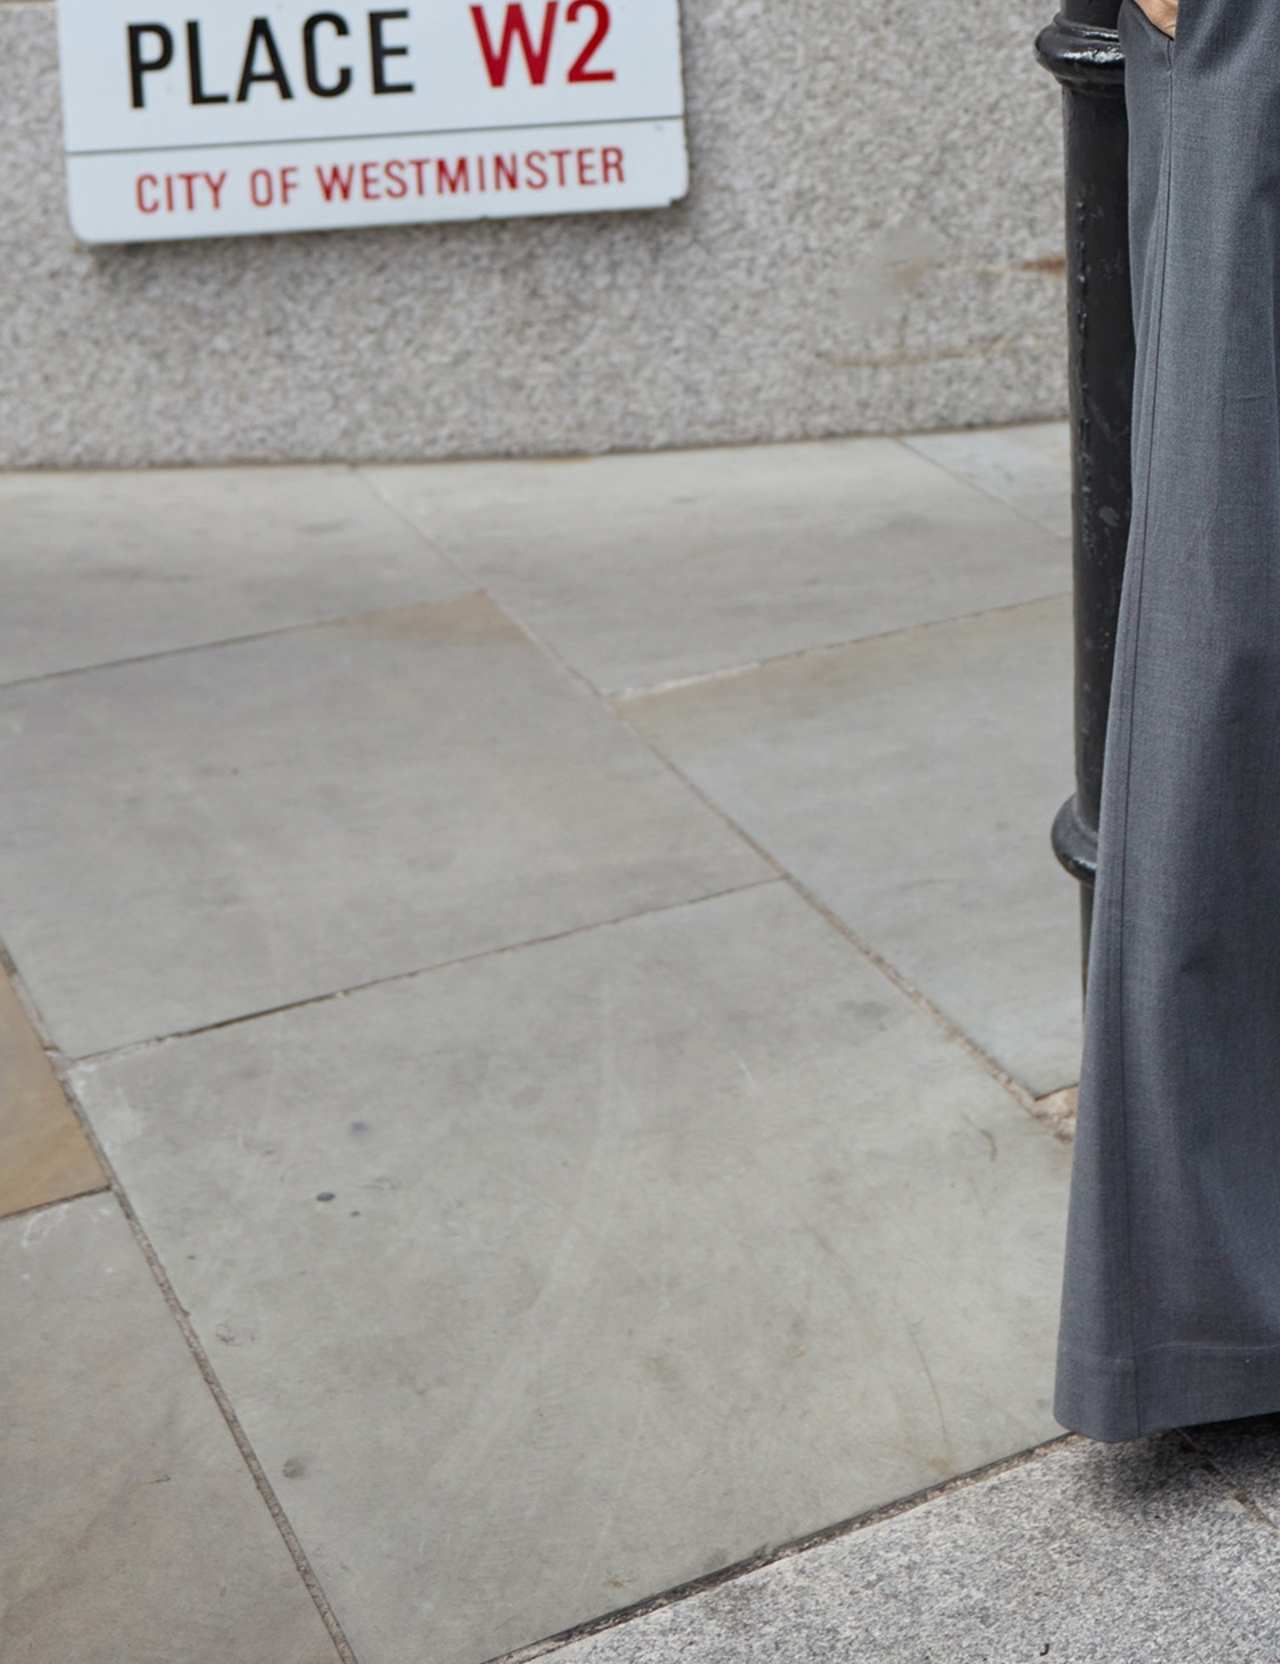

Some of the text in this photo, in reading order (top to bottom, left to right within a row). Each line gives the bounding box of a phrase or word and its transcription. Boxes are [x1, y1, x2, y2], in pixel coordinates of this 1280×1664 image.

[126, 10, 415, 109] PLACE
[135, 145, 625, 214] CITY OF WESTMINSTER
